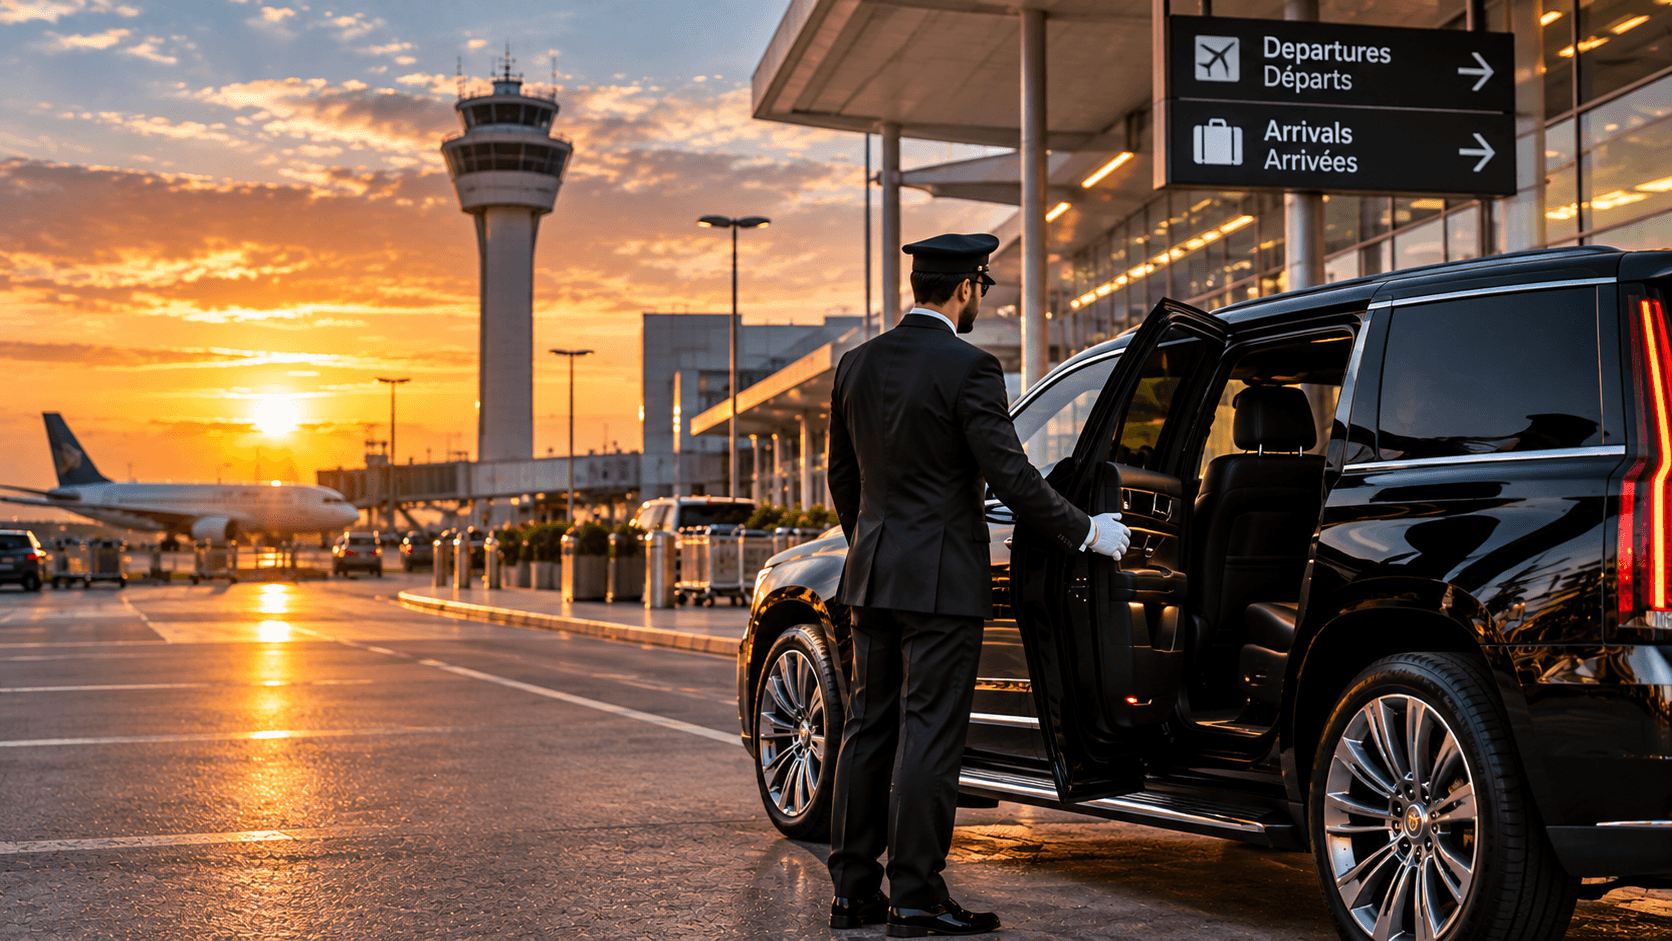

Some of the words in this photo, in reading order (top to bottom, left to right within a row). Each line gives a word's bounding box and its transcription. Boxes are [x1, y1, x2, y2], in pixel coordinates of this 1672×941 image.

[1264, 35, 1392, 65] Departures
[1264, 65, 1353, 93] Départs
[1264, 119, 1354, 144] Arrivals
[1264, 148, 1358, 173] Arrivées
